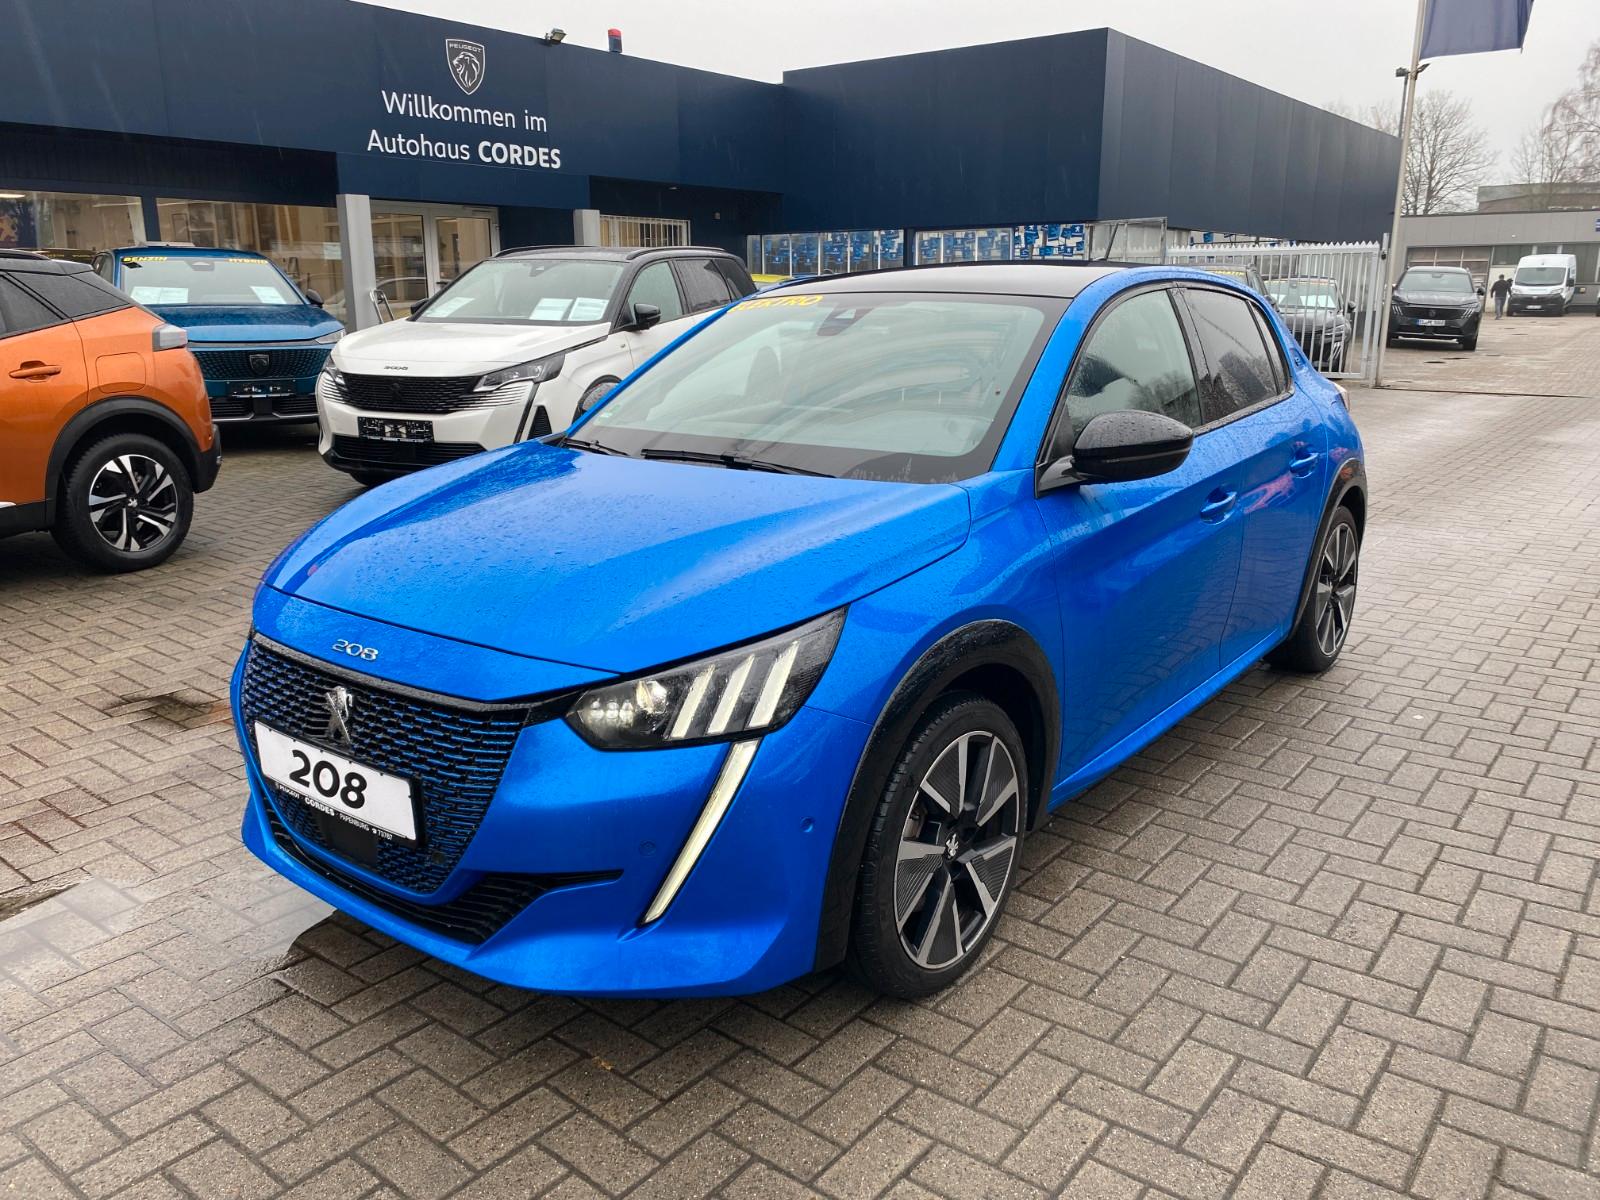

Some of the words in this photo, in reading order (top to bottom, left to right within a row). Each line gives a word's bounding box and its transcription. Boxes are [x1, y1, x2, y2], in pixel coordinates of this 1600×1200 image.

[449, 42, 482, 52] PEUGEOT
[382, 90, 516, 129] Willkommen
[524, 110, 547, 133] im
[367, 129, 471, 161] Autohaus
[477, 140, 561, 169] CORDES
[332, 638, 379, 661] 208
[289, 749, 368, 809] 208
[304, 796, 335, 817] CORDES
